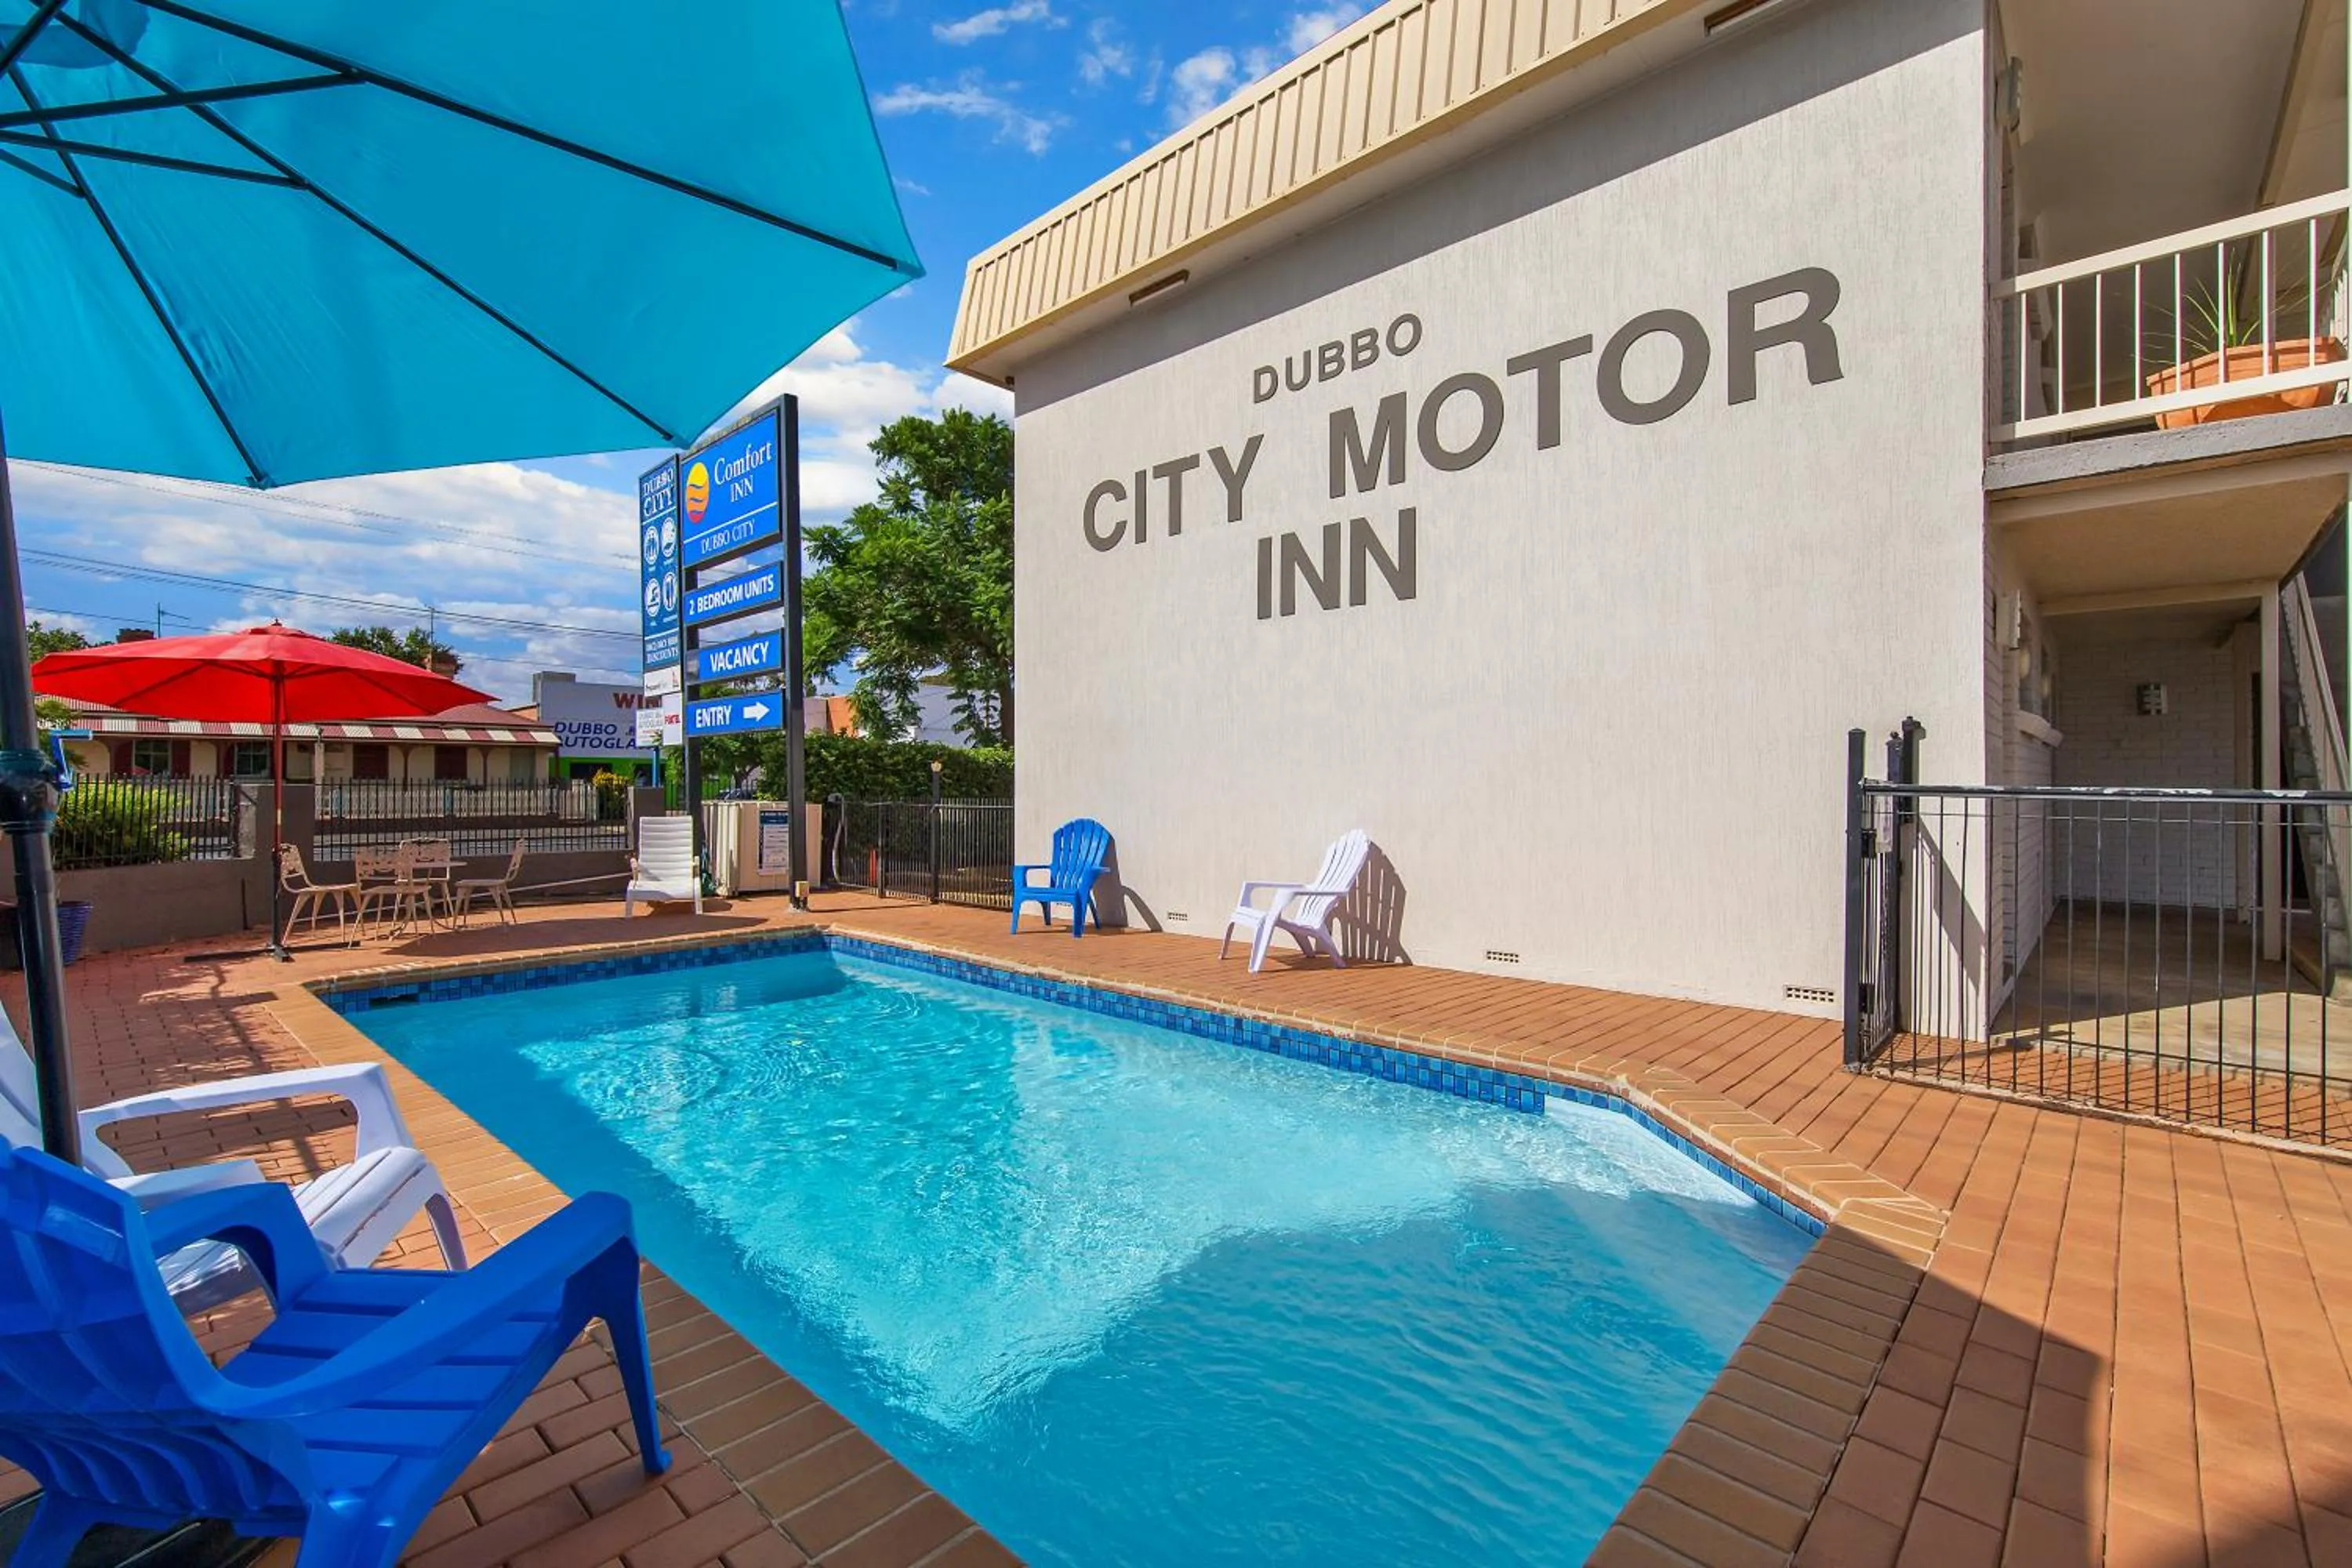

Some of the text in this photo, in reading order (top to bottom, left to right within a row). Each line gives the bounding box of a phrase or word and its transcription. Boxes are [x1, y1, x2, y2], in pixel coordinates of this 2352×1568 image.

[1254, 313, 1423, 405] DUBBO
[1083, 267, 1845, 553] CITY MOTOR
[714, 441, 772, 485] Comfort
[644, 468, 673, 496] DUBBO
[730, 474, 754, 503] INN
[644, 484, 674, 517] CITY
[702, 519, 755, 554] DUBBO CITY
[1257, 506, 1417, 620] INN
[689, 573, 775, 615] 2 BEDROOM UNITS
[710, 641, 769, 673] VACANCY
[554, 721, 618, 735] DUBBO
[695, 705, 731, 728] ENTRY
[558, 735, 652, 750] UTOGLA
